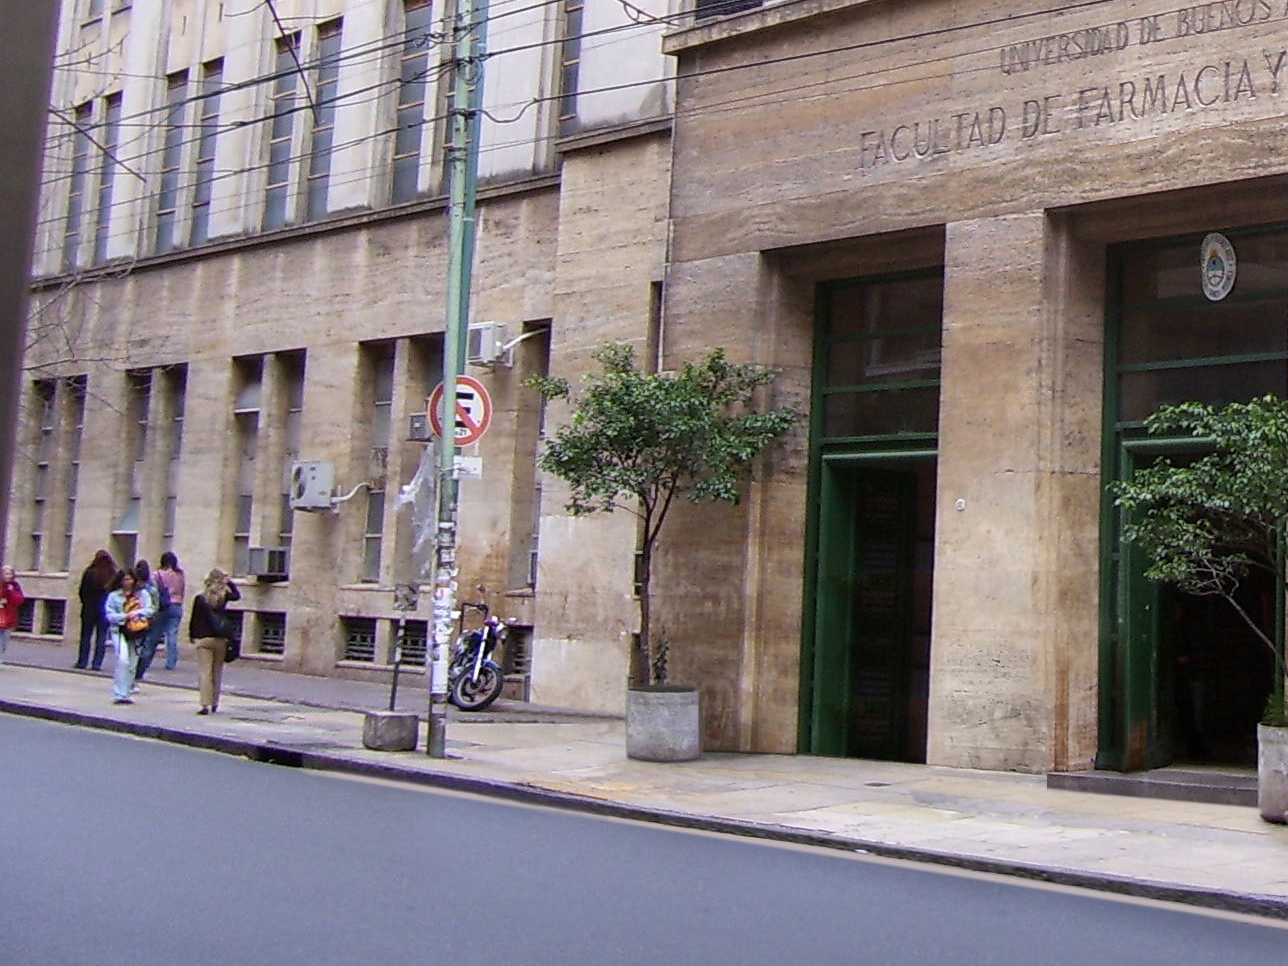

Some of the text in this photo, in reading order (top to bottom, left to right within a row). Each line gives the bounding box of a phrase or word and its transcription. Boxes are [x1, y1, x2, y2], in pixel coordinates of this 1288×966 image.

[1000, 21, 1129, 75] UNIVERSIDAD
[1139, 15, 1160, 45] DE
[855, 106, 1006, 170] FACULTAD
[1021, 94, 1062, 141] DE
[1076, 58, 1256, 130] FARMACIA
[1262, 49, 1288, 97] Y
